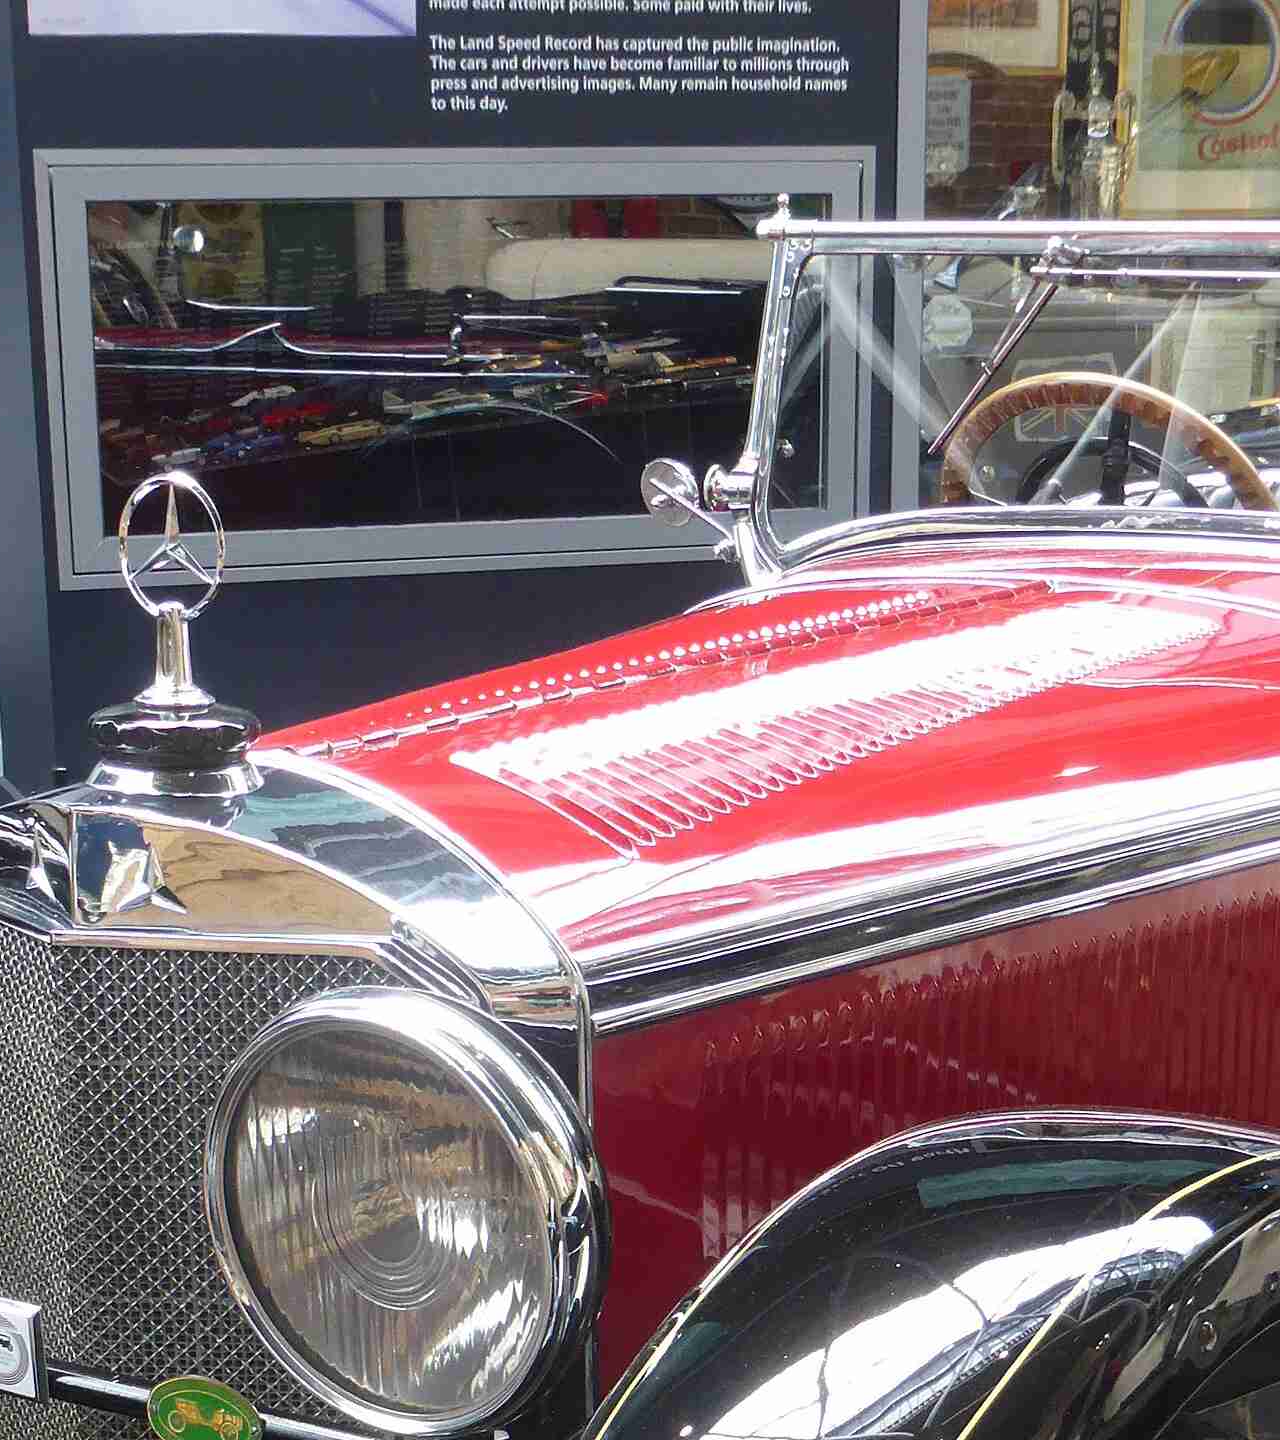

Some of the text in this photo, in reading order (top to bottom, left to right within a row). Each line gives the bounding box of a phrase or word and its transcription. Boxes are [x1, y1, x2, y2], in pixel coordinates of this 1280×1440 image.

[430, 0, 812, 14] made each attempt possible. Some paid with their lives.
[429, 35, 840, 54] The Land Speed Record has captured the public imagination.
[429, 55, 849, 74] The cars and drivers have become familiar to millions through
[431, 75, 848, 94] press and advertising images. Many remain household names
[431, 95, 508, 113] to this day.
